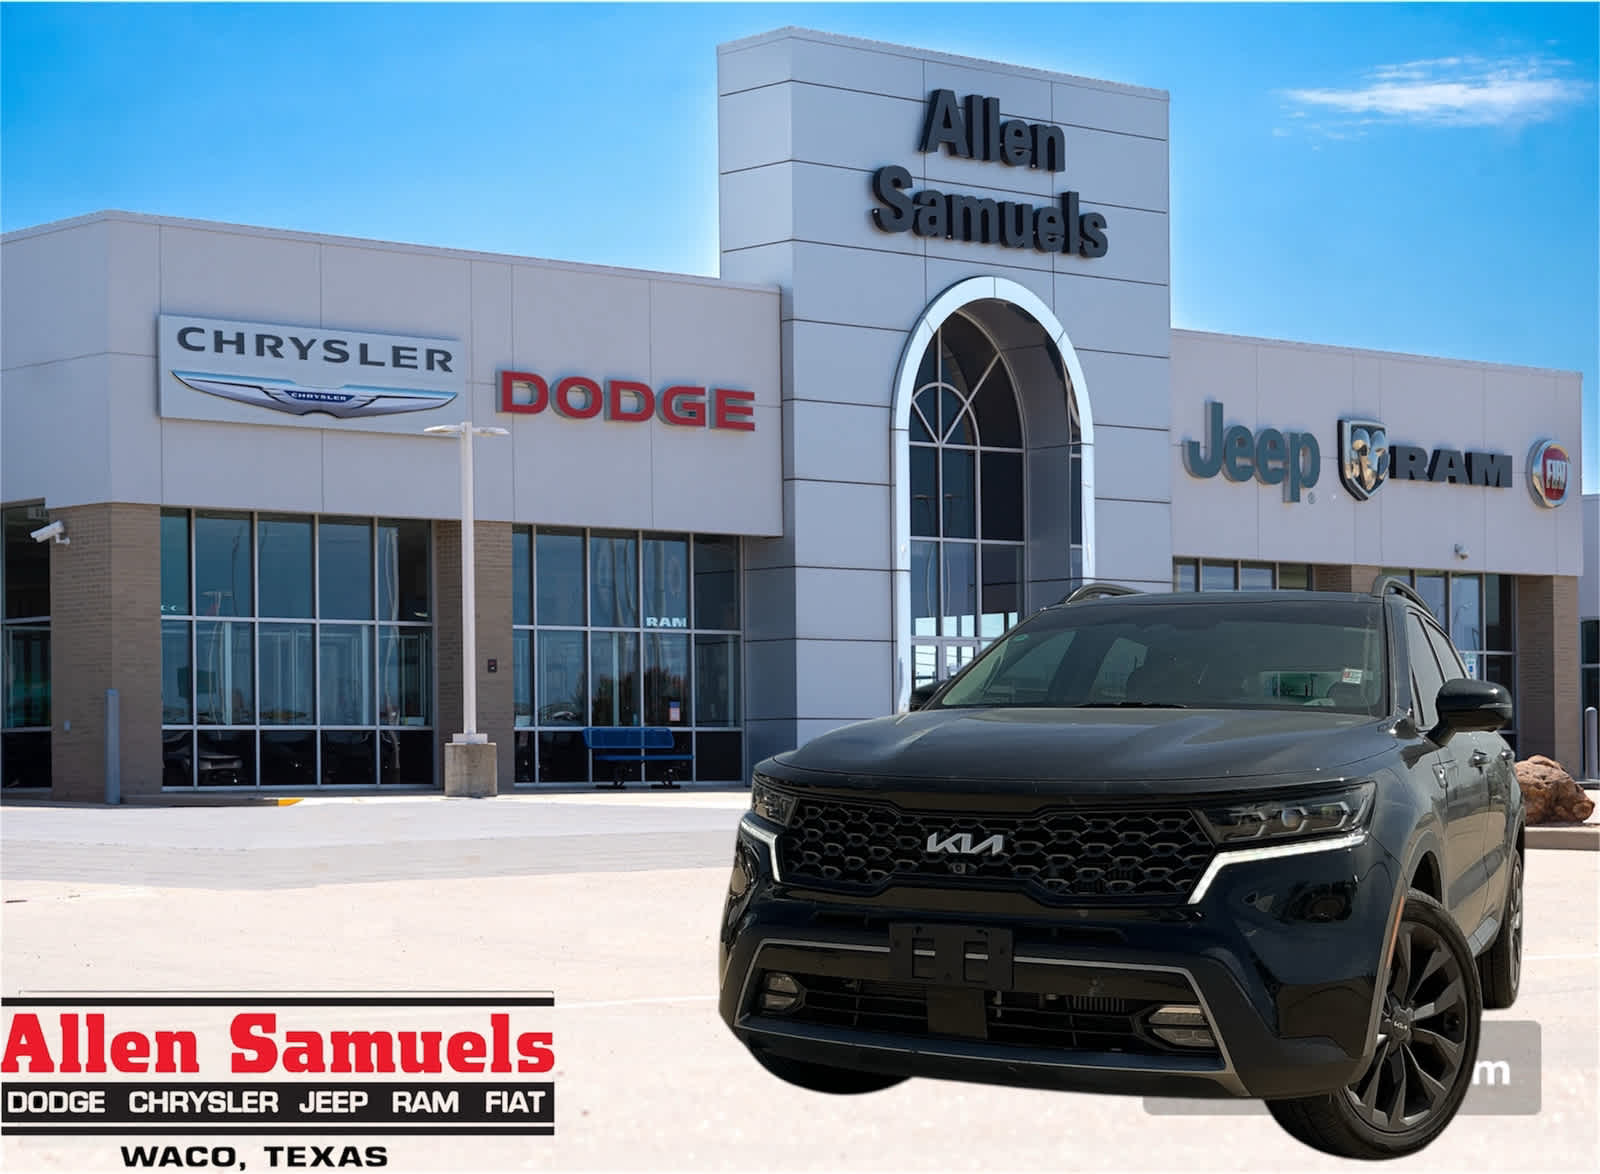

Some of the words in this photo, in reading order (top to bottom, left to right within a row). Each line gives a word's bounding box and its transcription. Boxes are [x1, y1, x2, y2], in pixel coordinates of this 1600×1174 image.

[919, 88, 1065, 172] Allen
[872, 165, 1108, 258] Samuels
[177, 326, 454, 373] CHRYSLER
[291, 391, 347, 401] CHRYSLER
[496, 370, 755, 432] DODGE
[1182, 401, 1321, 503] Jeep
[1389, 444, 1513, 488] RAM
[646, 616, 687, 628] RAM
[926, 832, 1004, 856] KIA
